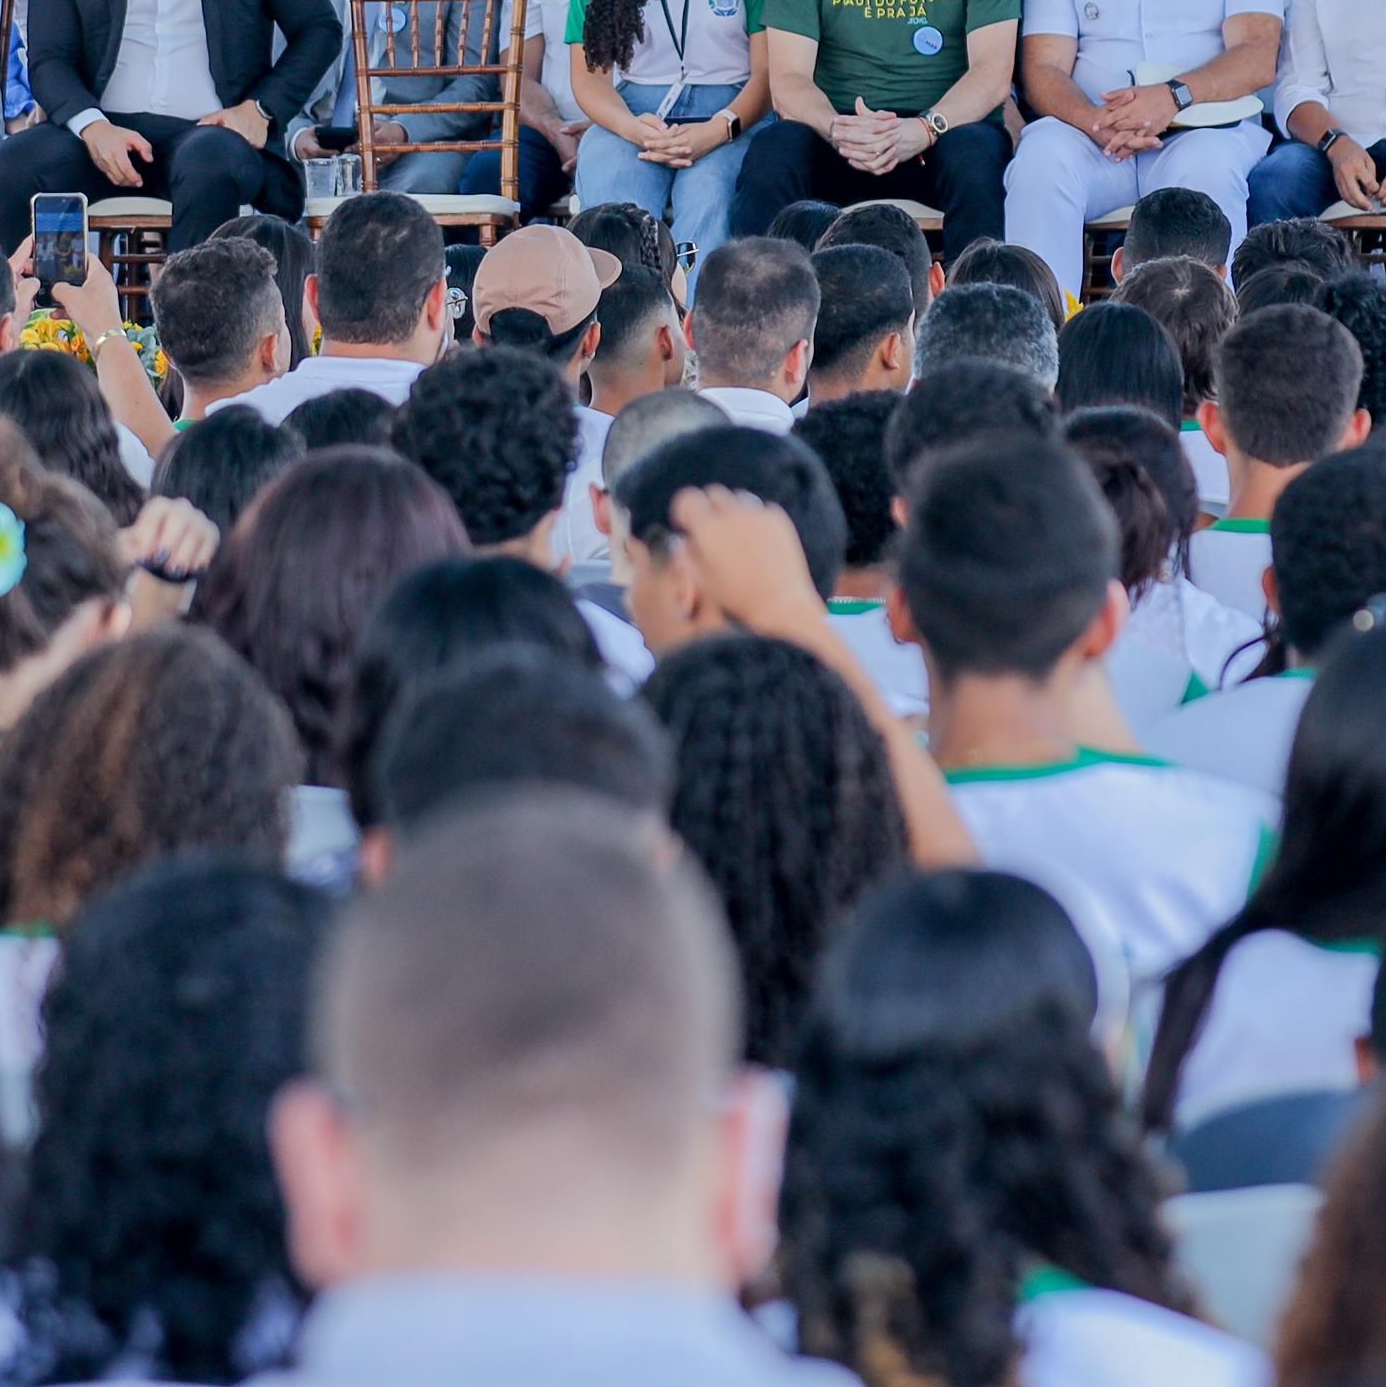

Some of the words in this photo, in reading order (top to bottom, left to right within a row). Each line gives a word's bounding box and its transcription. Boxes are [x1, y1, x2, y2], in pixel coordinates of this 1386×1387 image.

[863, 6, 872, 18] É
[876, 7, 906, 18] PRA
[908, 4, 927, 17] JÁ
